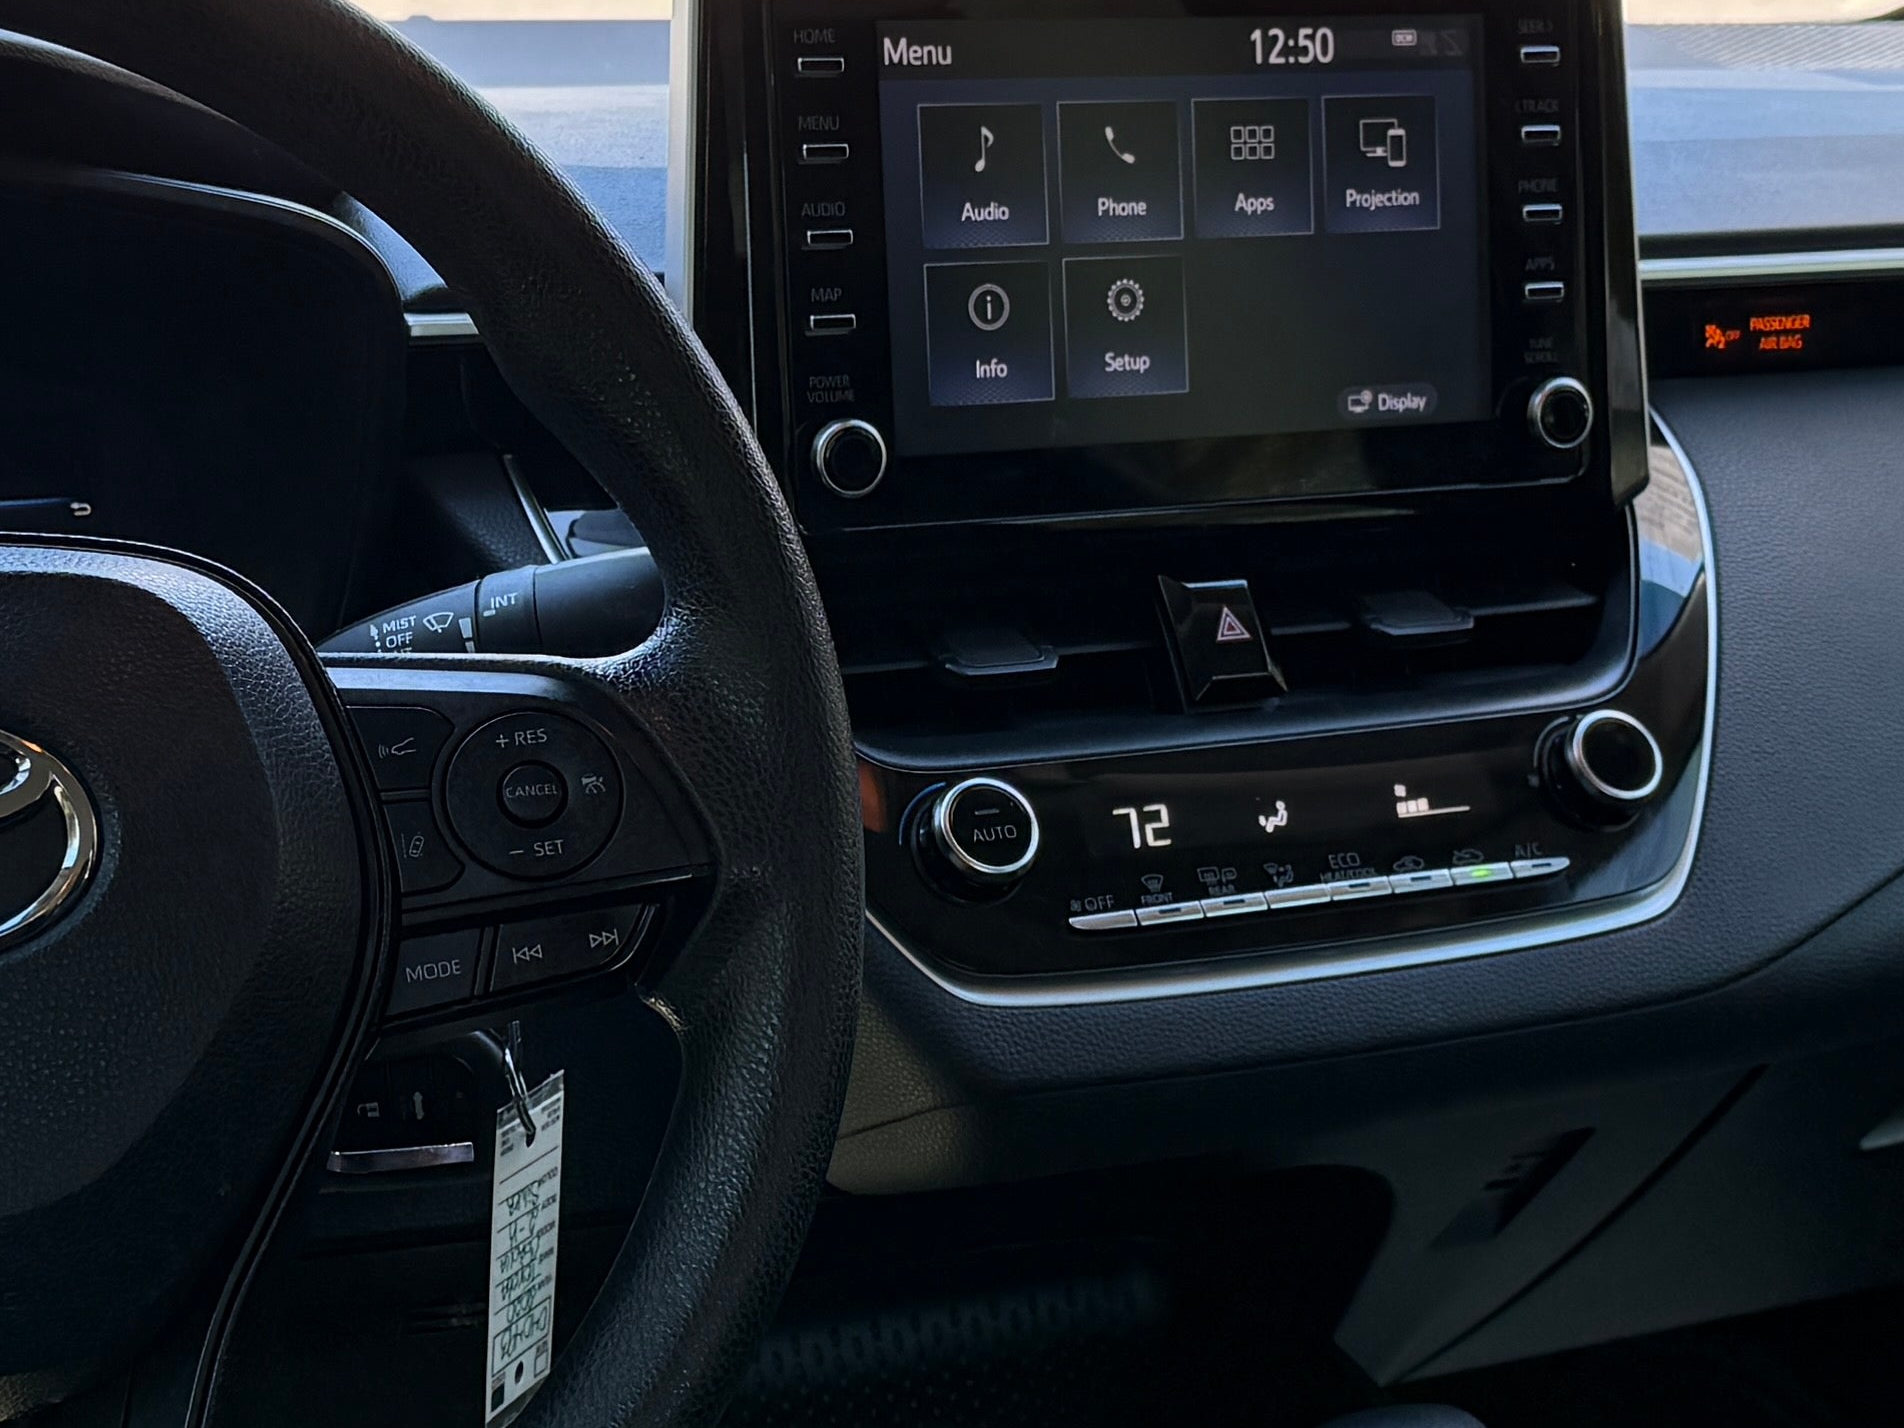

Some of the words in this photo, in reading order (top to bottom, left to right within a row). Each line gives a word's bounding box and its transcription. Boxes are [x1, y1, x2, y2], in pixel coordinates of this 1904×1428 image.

[793, 29, 836, 45] HOME
[882, 37, 953, 68] Menu
[1249, 27, 1336, 66] 12:50
[797, 115, 841, 132] MENU
[1097, 196, 1148, 219] Phone
[1234, 192, 1276, 217] Apps
[1345, 187, 1421, 212] Projection
[800, 201, 846, 218] AUDIO
[961, 201, 1010, 225] Audio
[810, 286, 843, 303] MAP
[1749, 314, 1811, 332] PASSENGER
[975, 357, 1008, 380] Info
[1104, 351, 1151, 375] Setup
[808, 375, 851, 391] POWER
[806, 388, 857, 403] VOLUME
[1377, 390, 1427, 413] Display
[490, 592, 518, 610] INT
[382, 615, 417, 633] MIST
[385, 632, 413, 649] OFF
[514, 728, 548, 746] RES
[505, 783, 559, 798] CANCEL
[972, 821, 1018, 843] AUTO
[1111, 803, 1173, 849] 72
[534, 839, 564, 857] SET
[1514, 842, 1544, 857] A/C
[1327, 852, 1361, 869] ECO
[1140, 892, 1173, 906] FRONT
[1208, 884, 1237, 896] REAR
[1084, 894, 1116, 912] OFF
[405, 959, 462, 983] MODE
